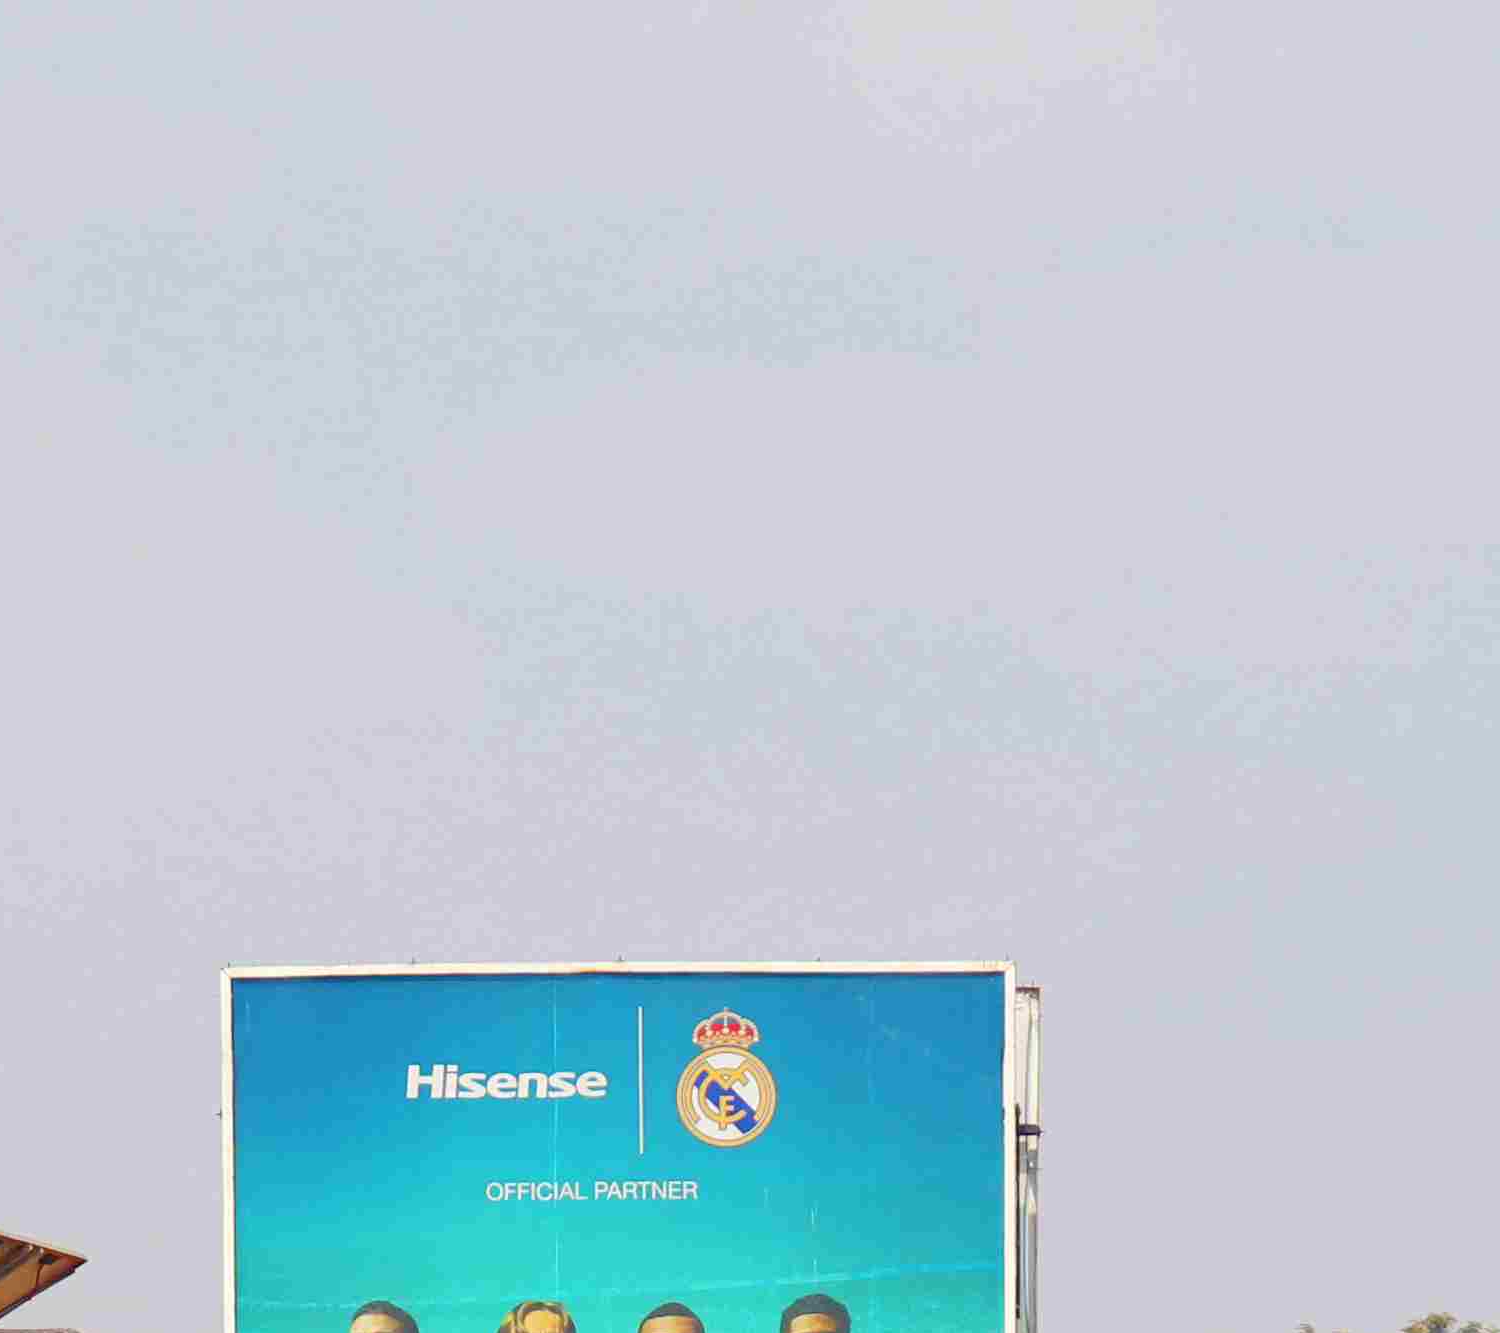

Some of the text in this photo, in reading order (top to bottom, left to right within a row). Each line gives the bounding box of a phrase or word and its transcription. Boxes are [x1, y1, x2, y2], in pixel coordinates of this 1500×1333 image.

[406, 1063, 608, 1100] Hisense
[485, 1180, 699, 1203] OFFICIAL PARTNER
